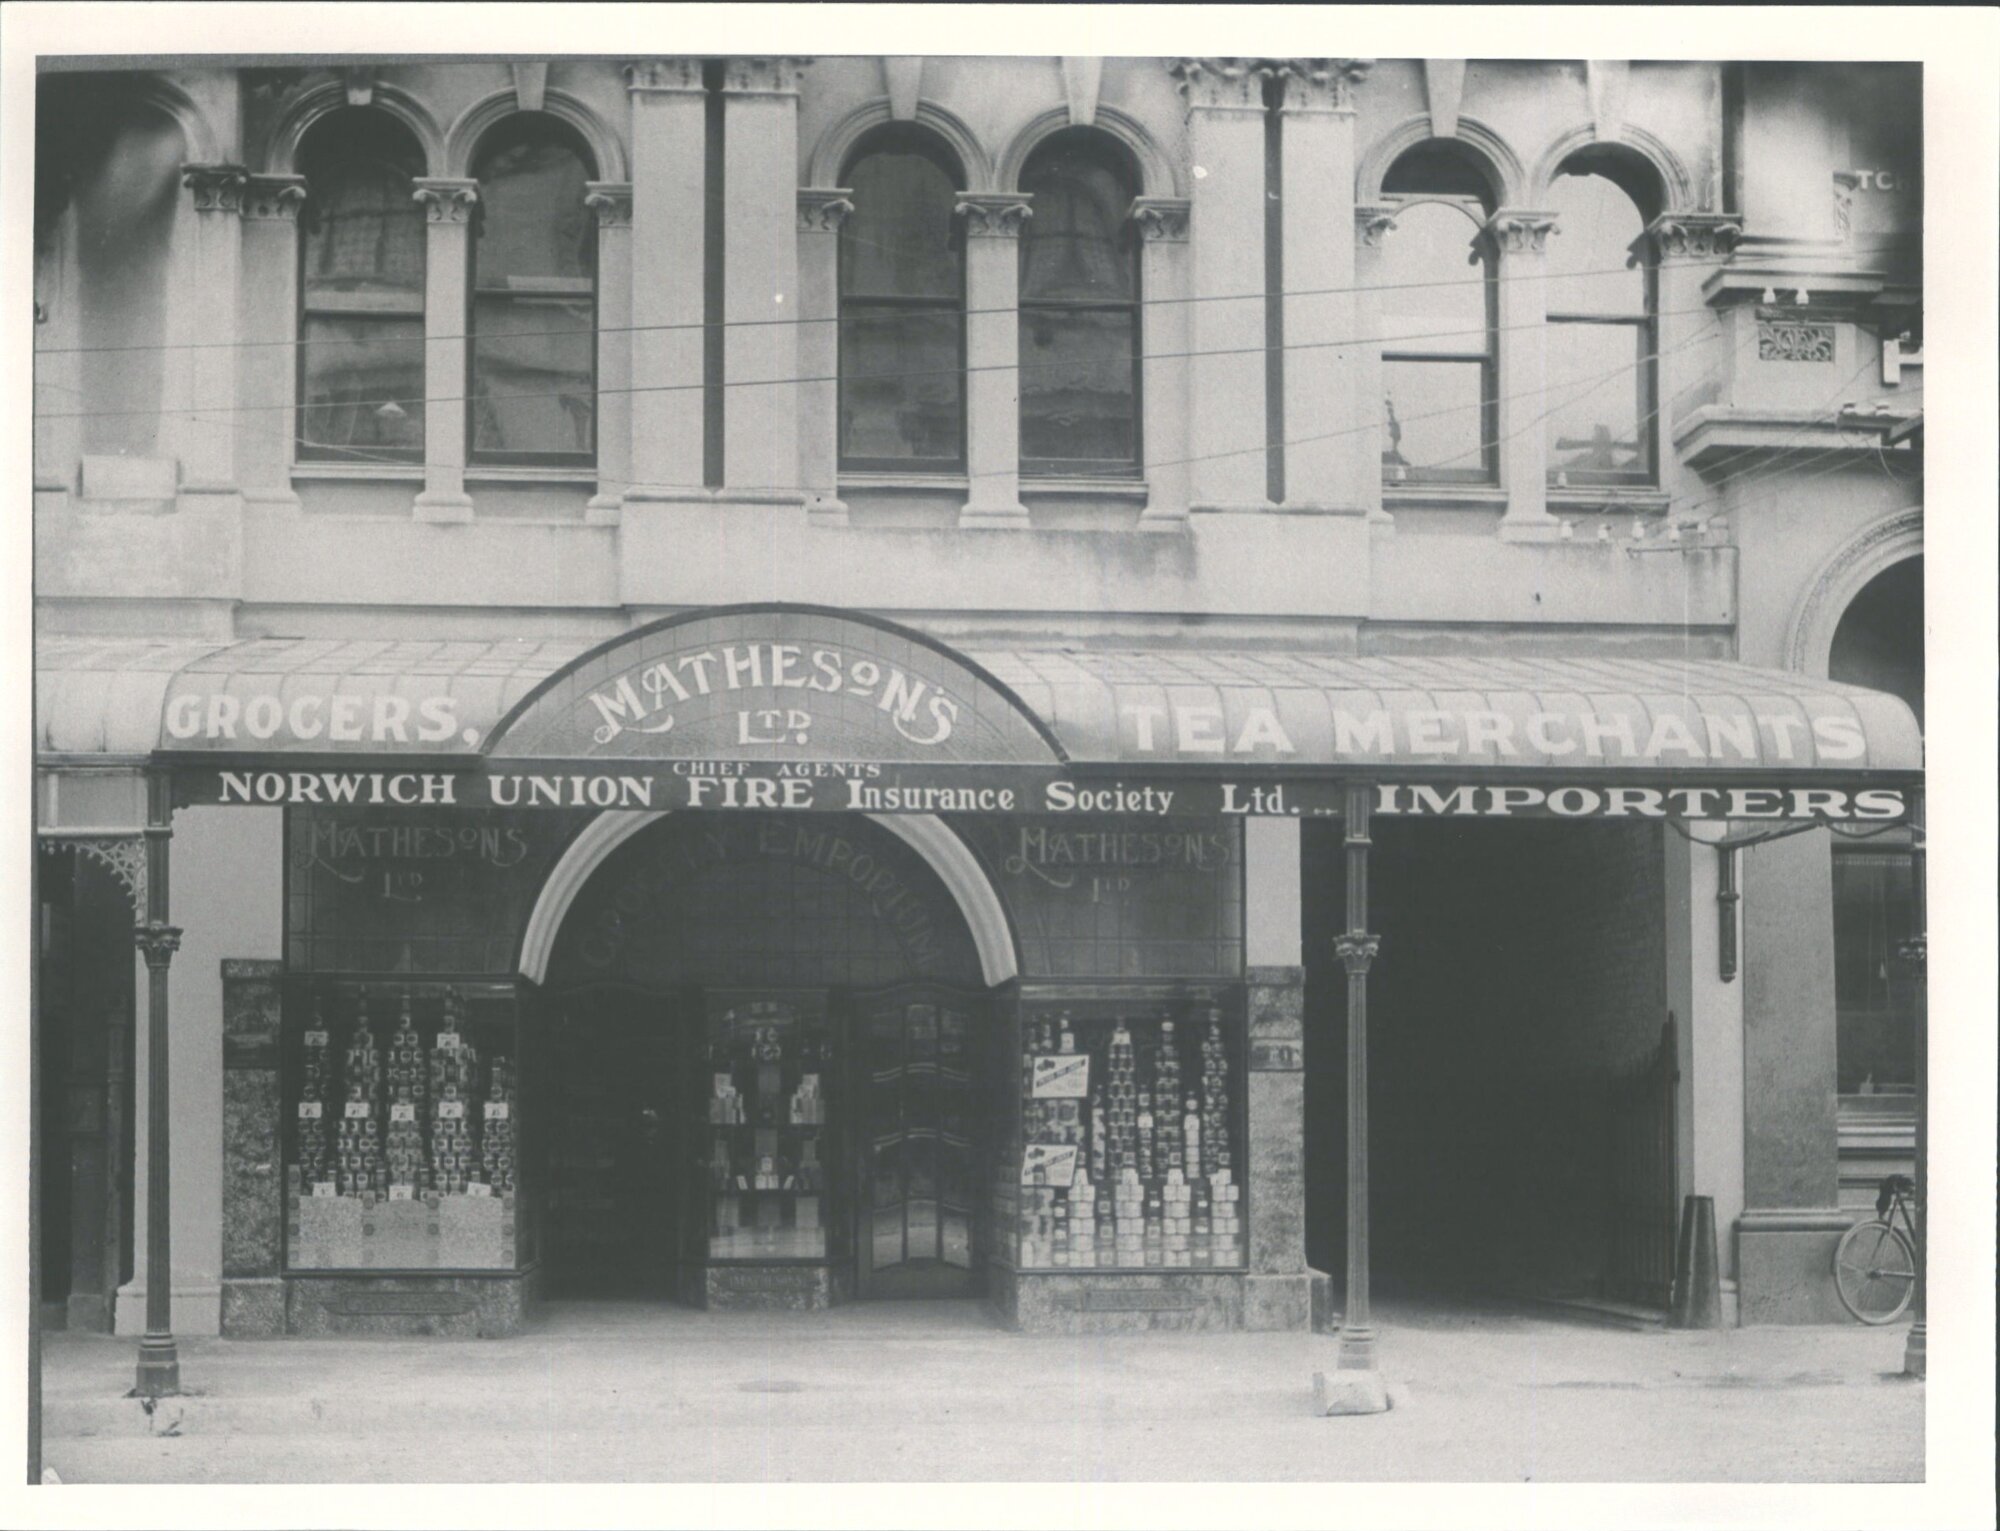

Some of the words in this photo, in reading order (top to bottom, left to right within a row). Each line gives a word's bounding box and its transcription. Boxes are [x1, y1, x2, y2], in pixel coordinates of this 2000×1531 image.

[166, 693, 479, 744] GROCERS,
[1129, 705, 1295, 753] TEA
[1333, 709, 1867, 760] MERCHANTS
[673, 760, 751, 776] CHIEF
[777, 762, 881, 778] AGENTS
[219, 772, 456, 804] NORWICH
[490, 775, 653, 806] UNION
[687, 777, 814, 809] FIRE
[846, 779, 1014, 811] Insurance
[1045, 781, 1174, 816] Society
[1221, 784, 1301, 815] Ltd.
[1375, 784, 1905, 818] IMPORTERS
